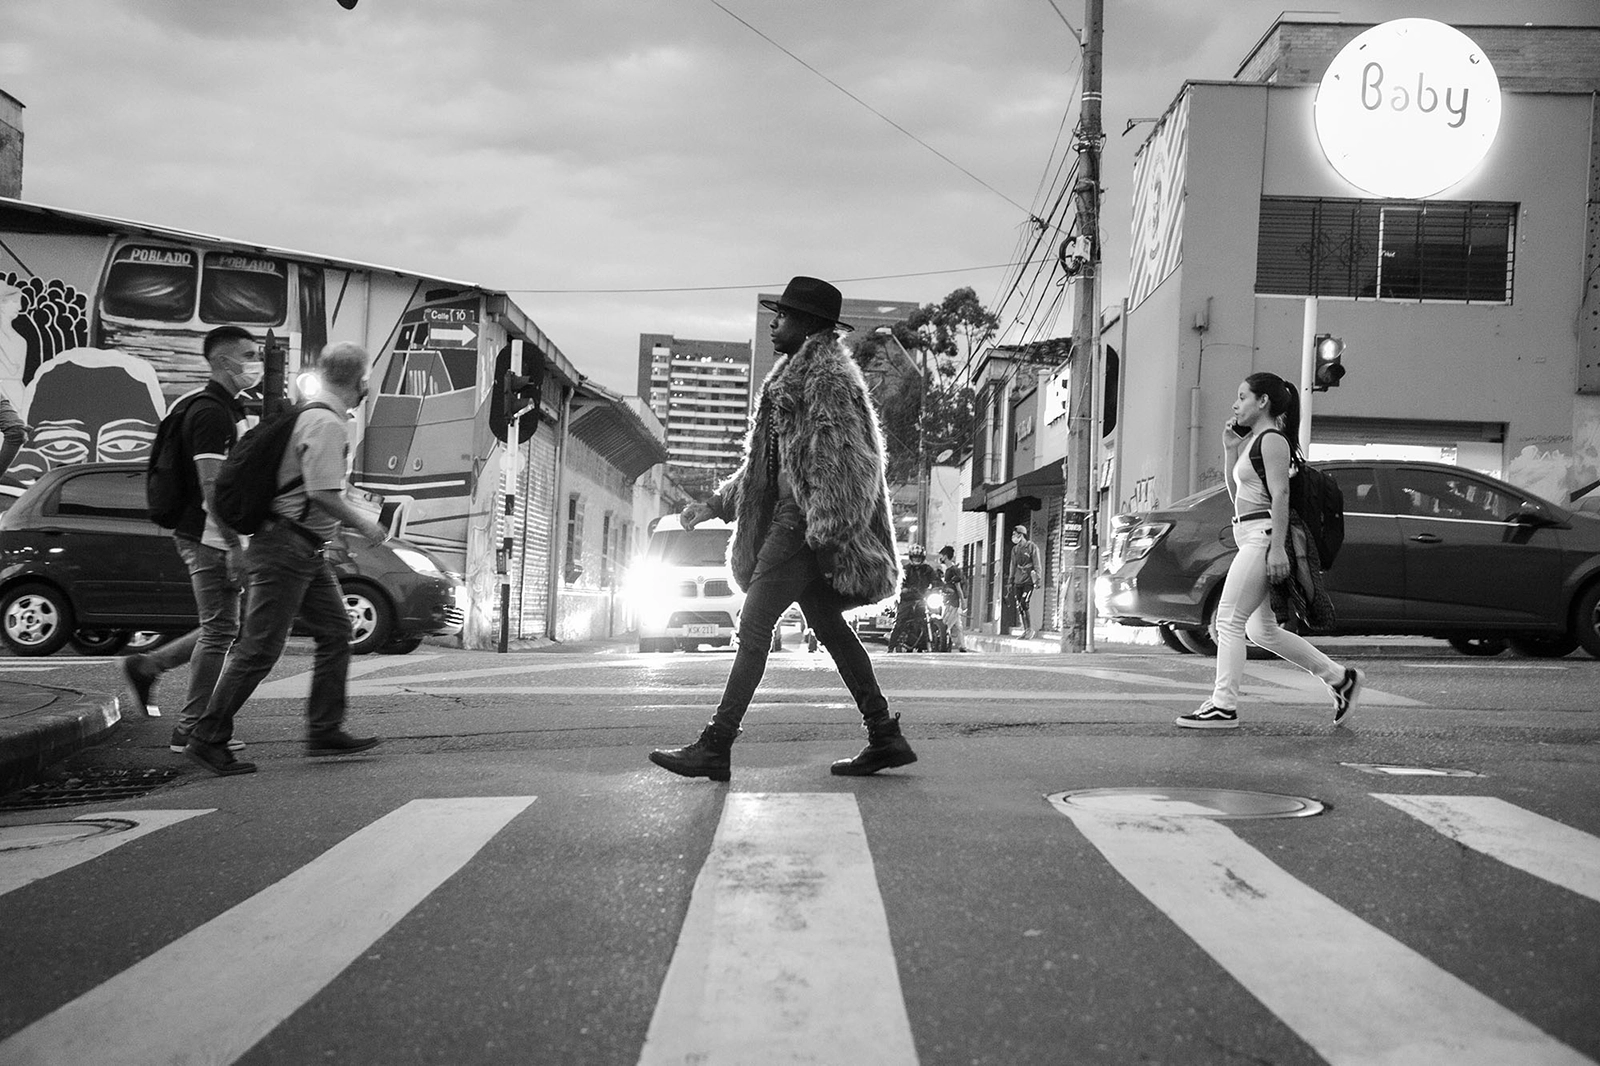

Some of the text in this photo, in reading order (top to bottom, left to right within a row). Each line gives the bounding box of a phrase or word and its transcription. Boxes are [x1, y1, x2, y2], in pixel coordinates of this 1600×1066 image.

[1361, 61, 1469, 129] Baby
[129, 249, 192, 265] POBLADO
[218, 255, 276, 272] POBLADO
